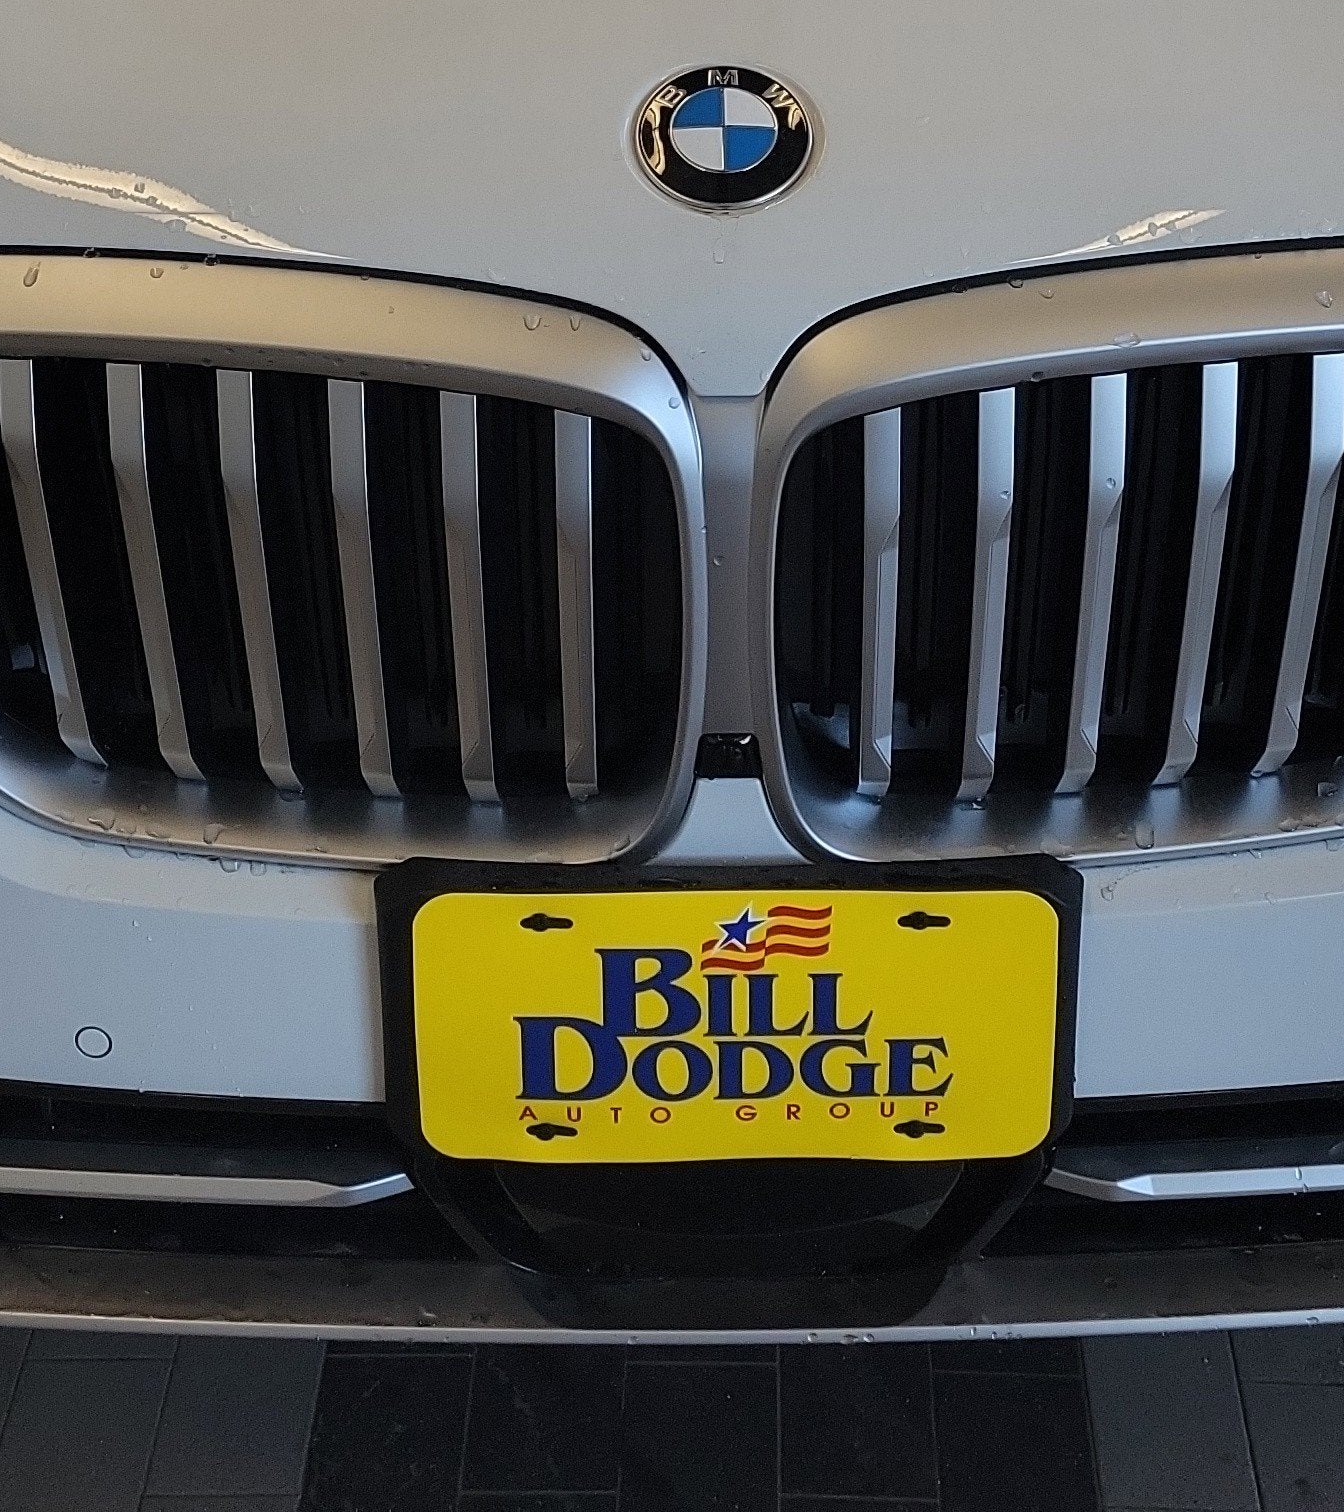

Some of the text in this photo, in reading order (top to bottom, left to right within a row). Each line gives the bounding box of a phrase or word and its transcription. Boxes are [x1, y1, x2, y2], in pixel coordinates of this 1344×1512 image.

[655, 69, 798, 109] BMW
[594, 947, 873, 1038] BILL
[512, 1015, 954, 1102] DODGE
[518, 1100, 939, 1124] AUTO GROUP
